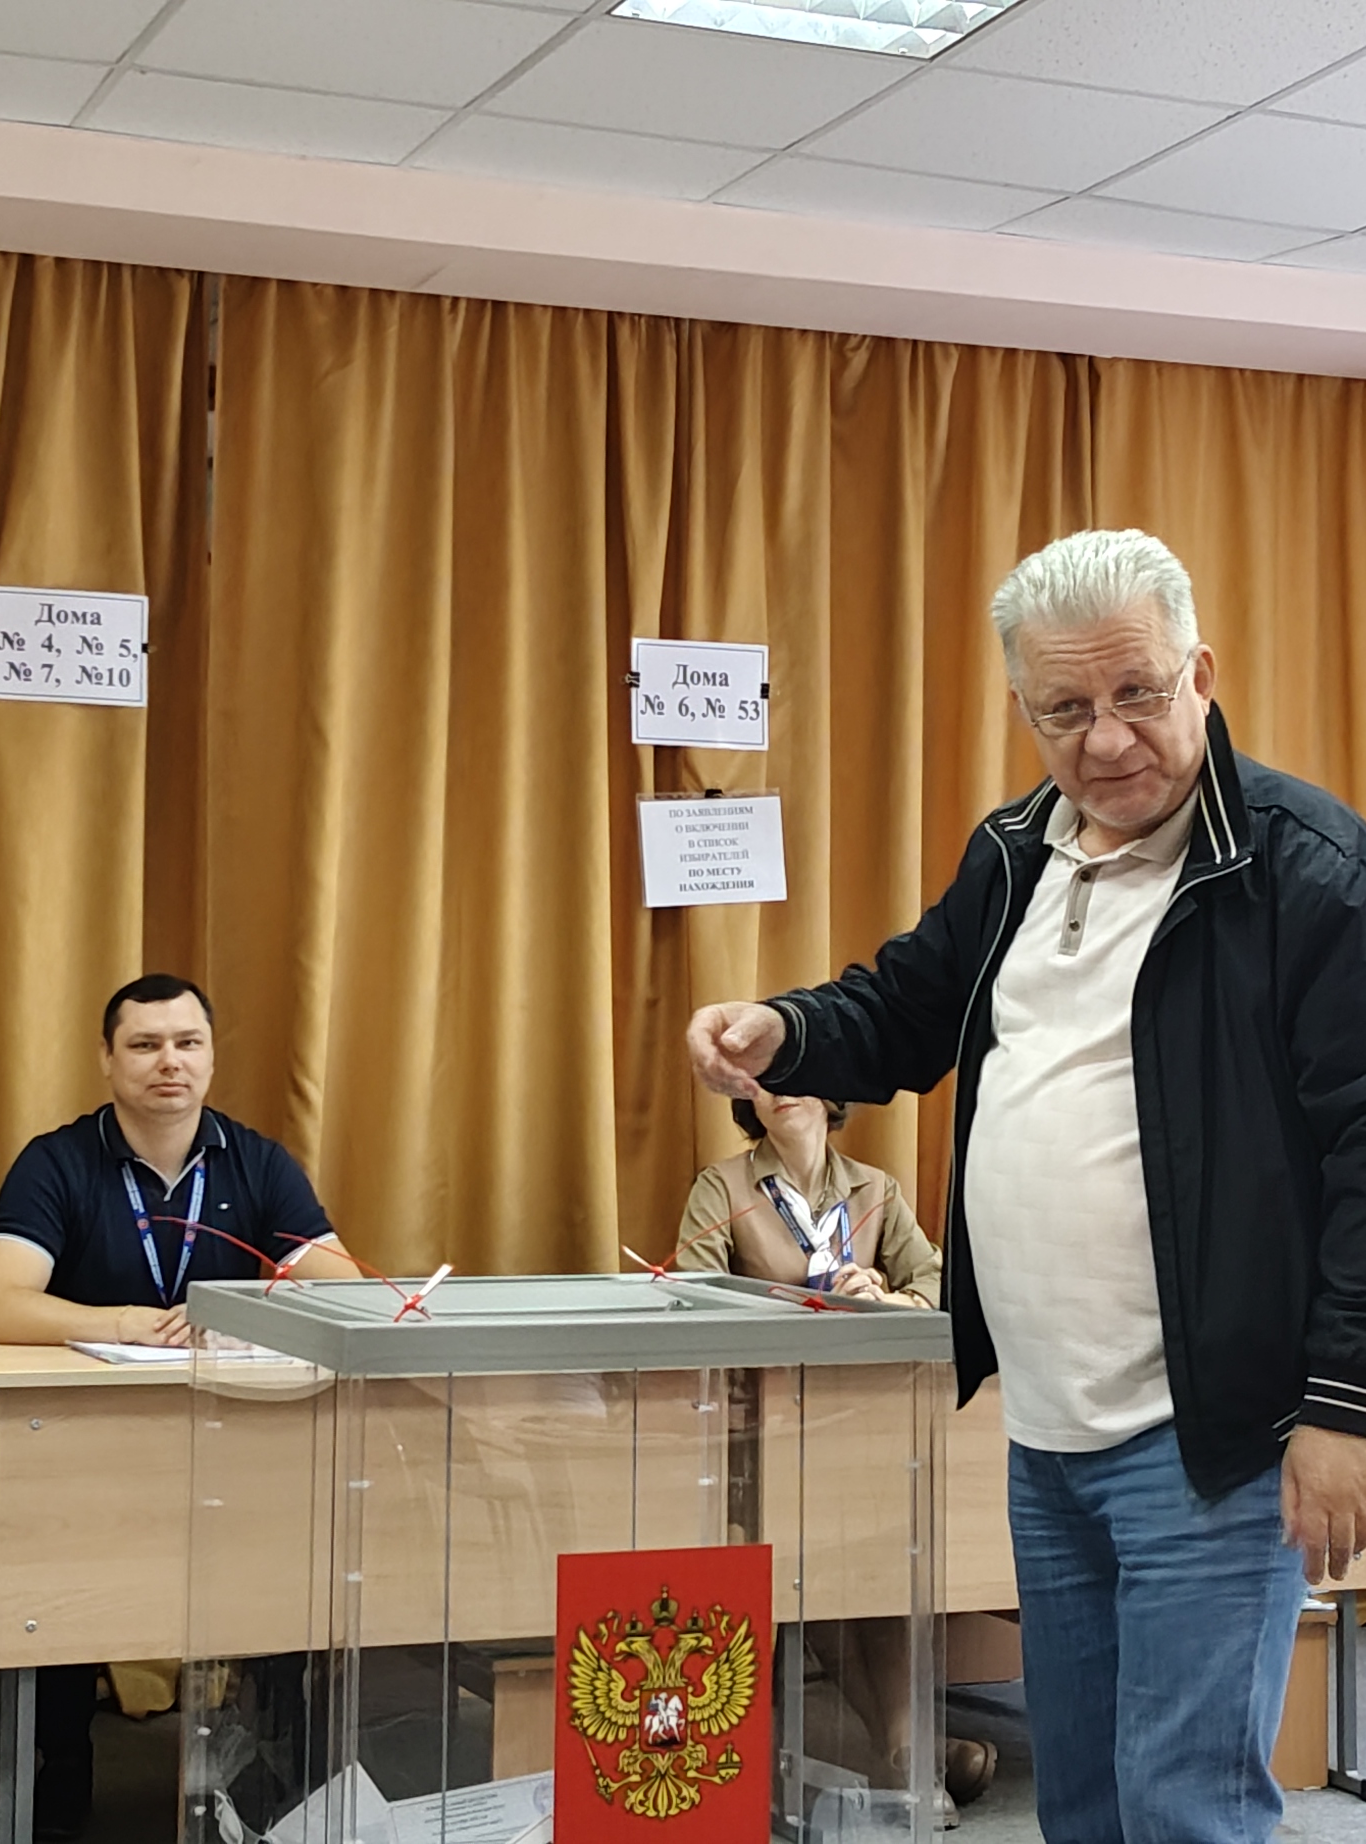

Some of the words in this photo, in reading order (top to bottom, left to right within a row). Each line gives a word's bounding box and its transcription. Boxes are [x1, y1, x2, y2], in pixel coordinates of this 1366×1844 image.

[34, 603, 103, 627] Дома
[40, 633, 62, 658] 4,
[75, 635, 104, 656] №
[118, 638, 139, 663] 5,
[3, 661, 32, 682] №
[40, 663, 61, 688] 7,
[671, 664, 730, 690] Дома
[640, 694, 665, 716] №
[677, 696, 696, 722] 6,
[701, 697, 726, 719] №
[737, 700, 760, 721] 53
[669, 808, 684, 818] ПО
[686, 806, 754, 818] ЗАЯВЛЕНИЯМ
[675, 824, 684, 833] О
[685, 822, 749, 833] ВКЛЮЧЕНИИ
[688, 839, 695, 848] В
[697, 838, 739, 848] СПИСОК
[679, 849, 750, 863] ИЗБИРАТЕЛЕЙ
[688, 868, 704, 878] ПО
[706, 866, 742, 877] МЕСТУ
[679, 880, 755, 892] НАХОЖДЕНИЯ
